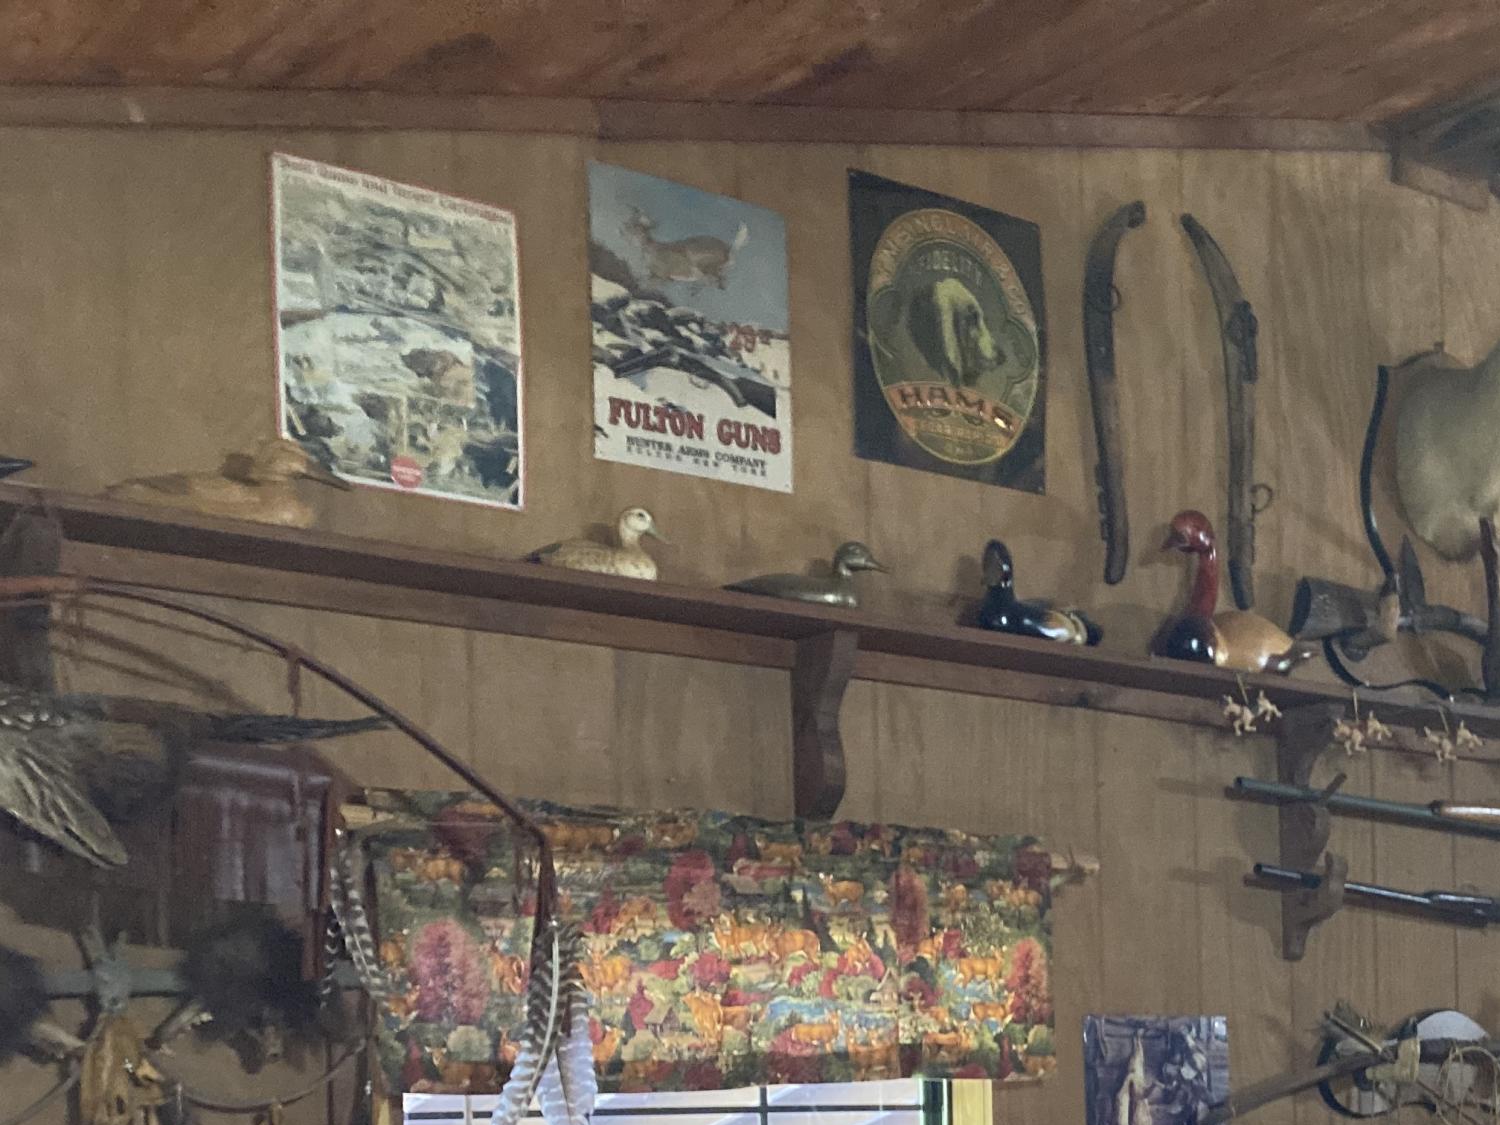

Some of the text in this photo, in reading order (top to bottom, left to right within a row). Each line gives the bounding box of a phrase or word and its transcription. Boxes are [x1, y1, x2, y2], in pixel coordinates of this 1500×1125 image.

[608, 397, 782, 455] FULTON GUNS
[715, 451, 767, 469] COMPANY
